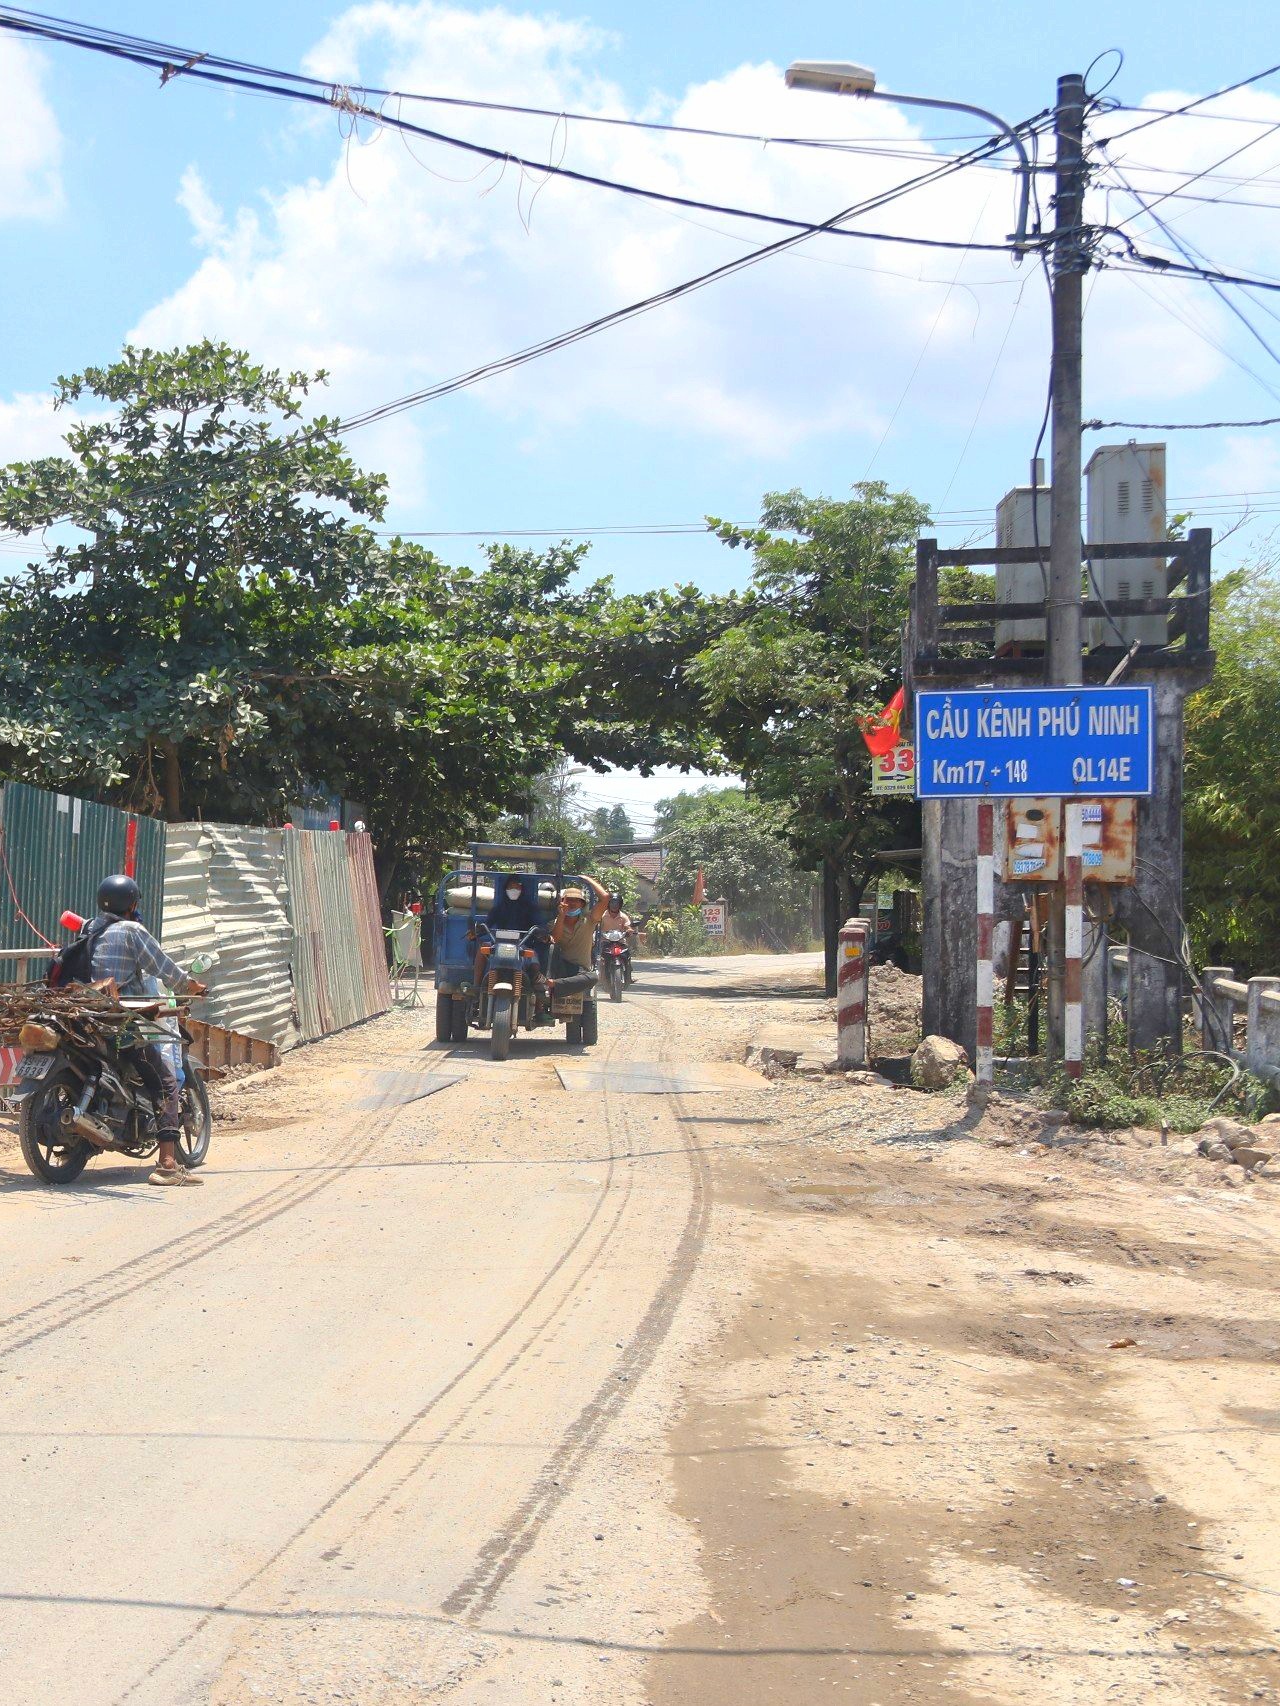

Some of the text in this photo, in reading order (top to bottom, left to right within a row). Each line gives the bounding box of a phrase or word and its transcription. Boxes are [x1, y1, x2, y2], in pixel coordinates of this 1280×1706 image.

[926, 696, 1139, 740] CẦU KÊNH PHÚ NINH
[932, 759, 986, 784] Km17
[1005, 759, 1028, 783] 148
[1072, 757, 1131, 782] QL14E
